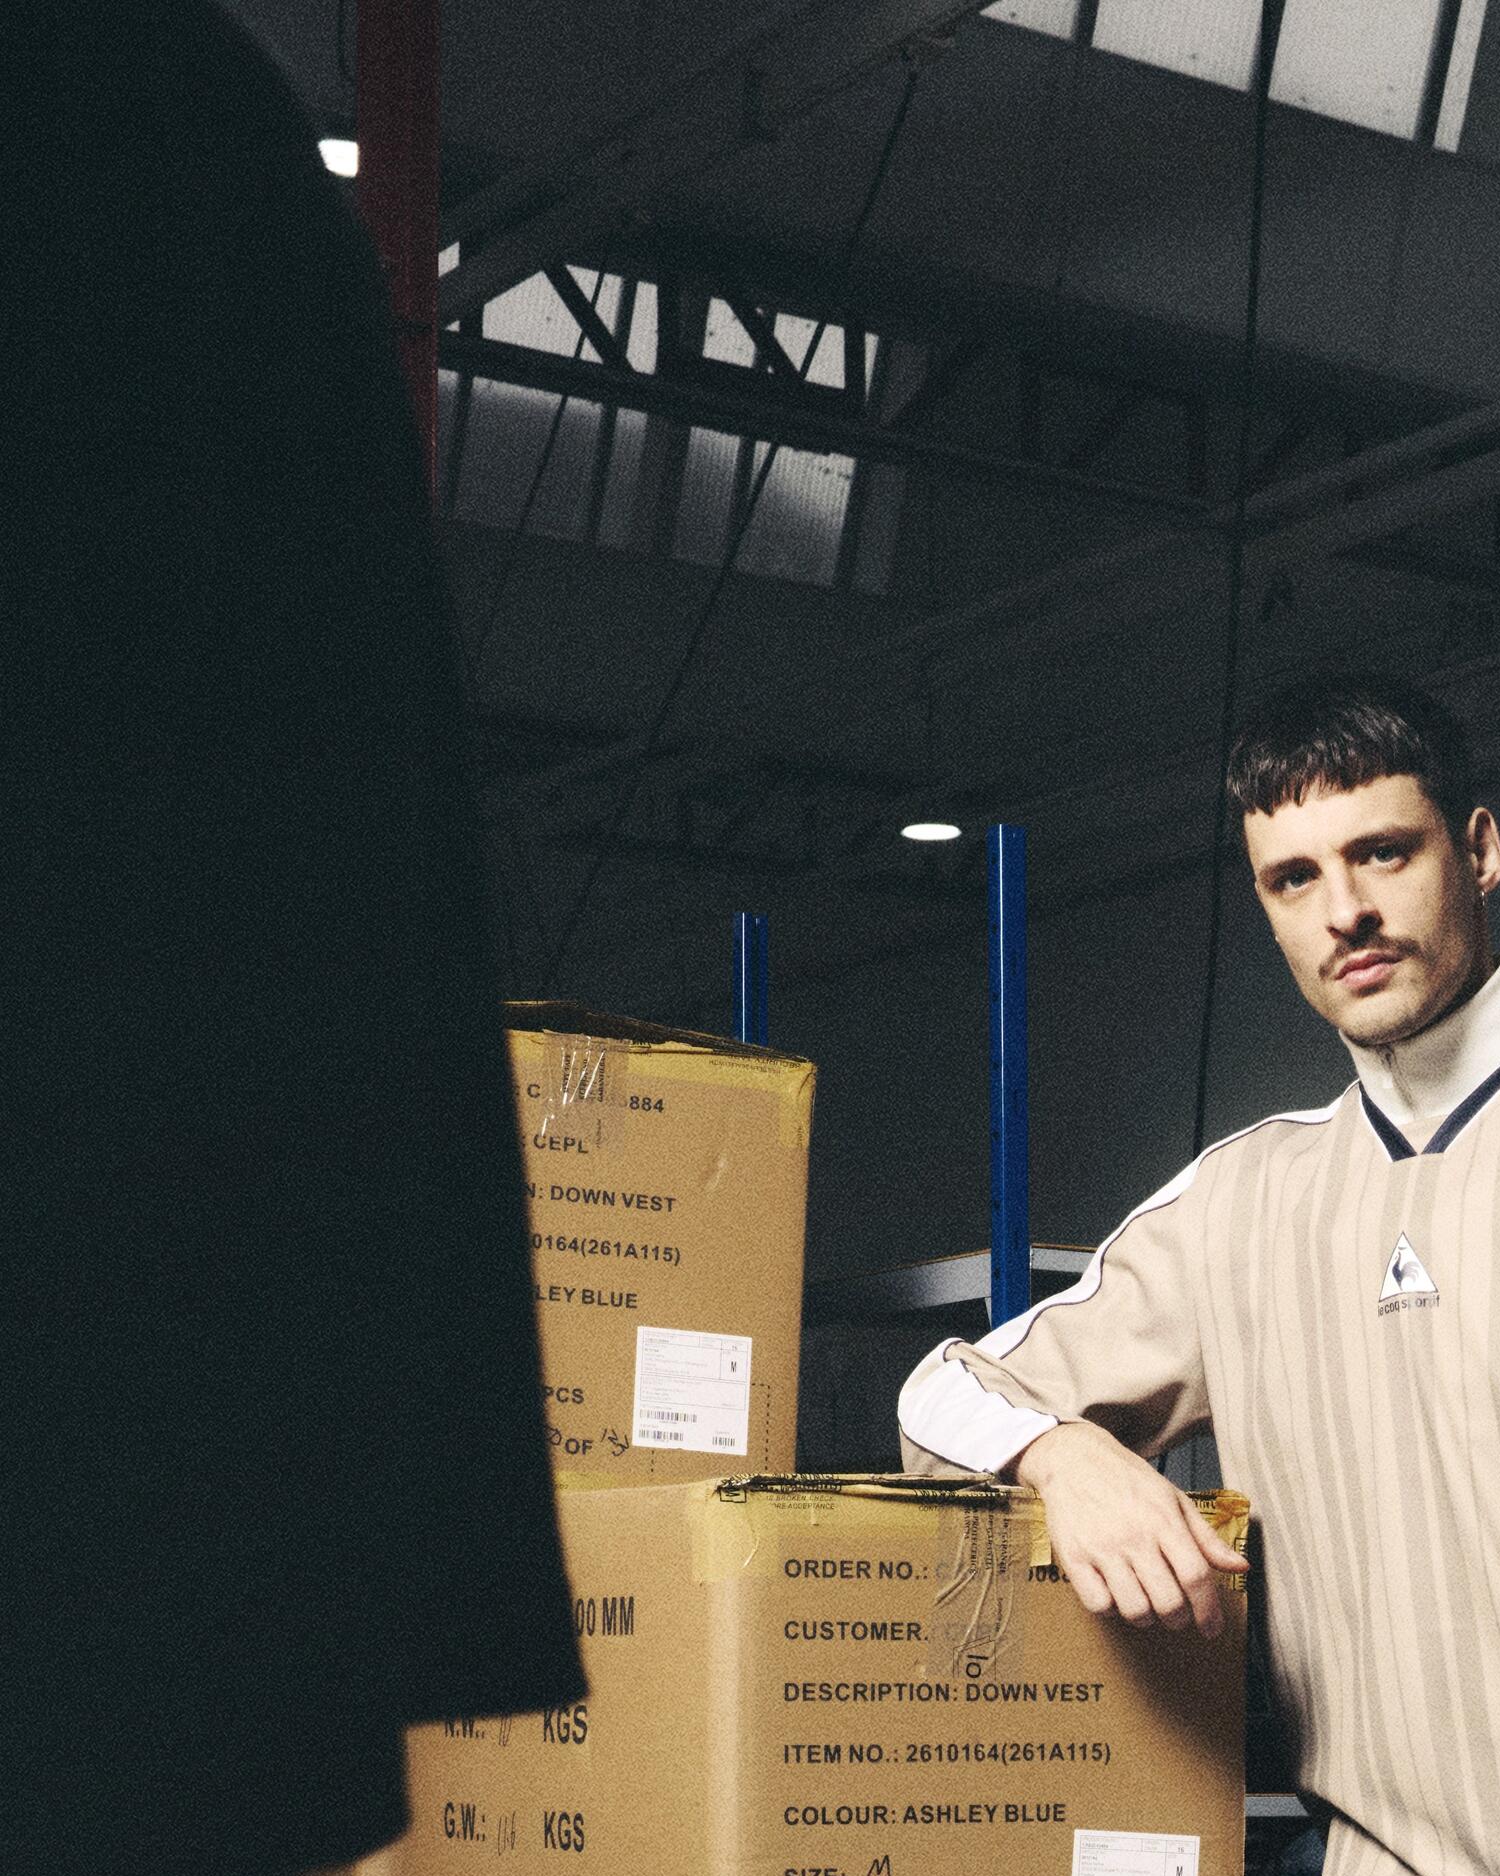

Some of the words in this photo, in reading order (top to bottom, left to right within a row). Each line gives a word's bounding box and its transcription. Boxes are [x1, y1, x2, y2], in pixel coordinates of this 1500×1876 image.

[550, 1184, 616, 1207] DOWN
[622, 1192, 676, 1212] VEST
[532, 1233, 681, 1266] 0164(261A115)
[536, 1285, 576, 1302] LEY
[581, 1288, 638, 1309] BLUE
[1384, 1300, 1400, 1314] coq
[730, 1361, 737, 1373] M
[565, 1438, 593, 1455] OF
[784, 1559, 872, 1580] ORDER
[878, 1560, 929, 1580] NO.:
[602, 1596, 635, 1635] MM
[783, 1682, 958, 1702] DESCRIPTION:
[965, 1682, 1037, 1702] DOWN
[1044, 1682, 1104, 1702] VEST
[543, 1705, 588, 1745] KGS
[783, 1744, 841, 1764] ITEM
[849, 1743, 899, 1763] NO.:
[906, 1742, 1111, 1766] 2610164(261A115)
[783, 1805, 897, 1826] COLOUR:
[902, 1803, 998, 1824] ASHLEY
[1004, 1803, 1067, 1823] BLUE
[443, 1801, 486, 1842] G.W.:
[543, 1811, 585, 1853] KGS
